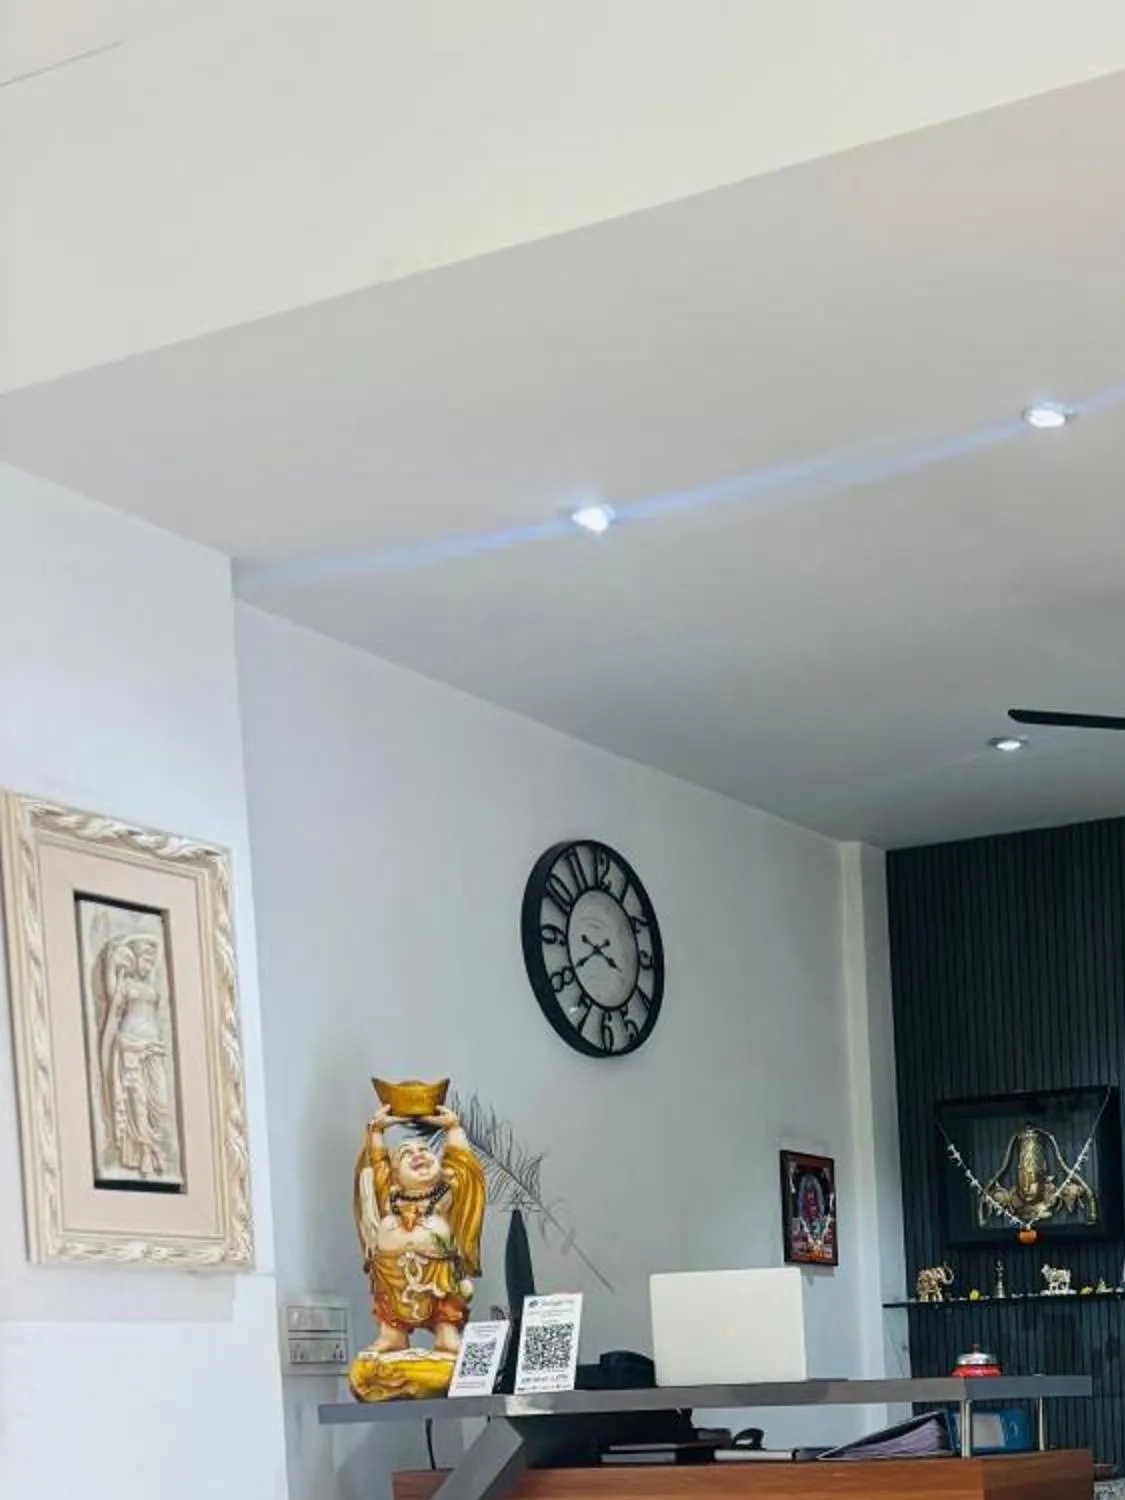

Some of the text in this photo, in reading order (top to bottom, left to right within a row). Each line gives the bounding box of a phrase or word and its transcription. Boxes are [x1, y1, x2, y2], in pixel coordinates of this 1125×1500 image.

[593, 846, 612, 891] 12
[540, 923, 567, 946] 9
[549, 965, 576, 993] 8
[601, 1010, 614, 1053] 6
